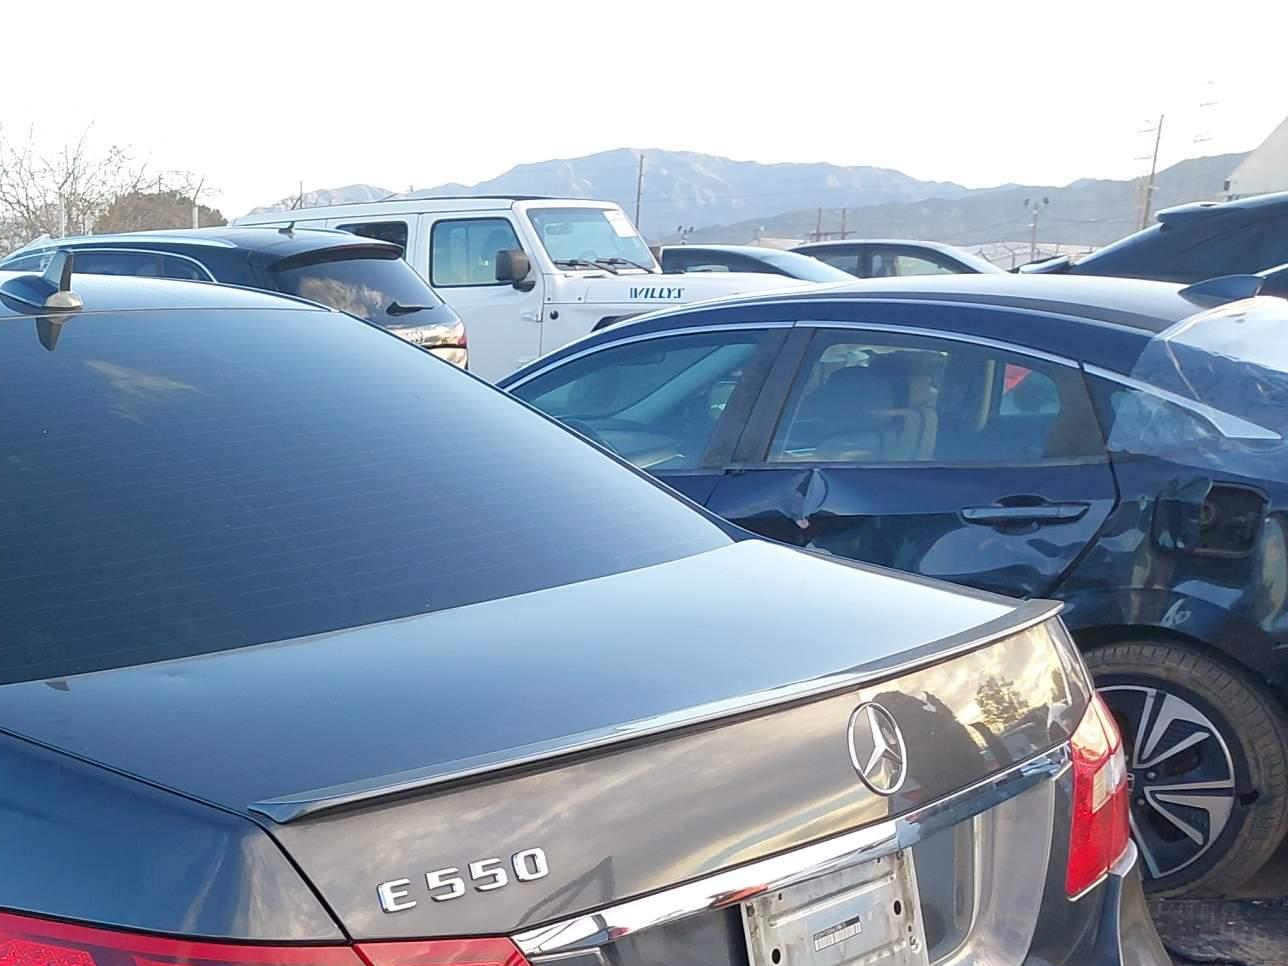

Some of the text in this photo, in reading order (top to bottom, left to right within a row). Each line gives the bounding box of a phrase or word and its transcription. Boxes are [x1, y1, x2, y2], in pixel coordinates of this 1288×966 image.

[629, 287, 685, 299] WILLYS
[376, 847, 549, 914] E 550
